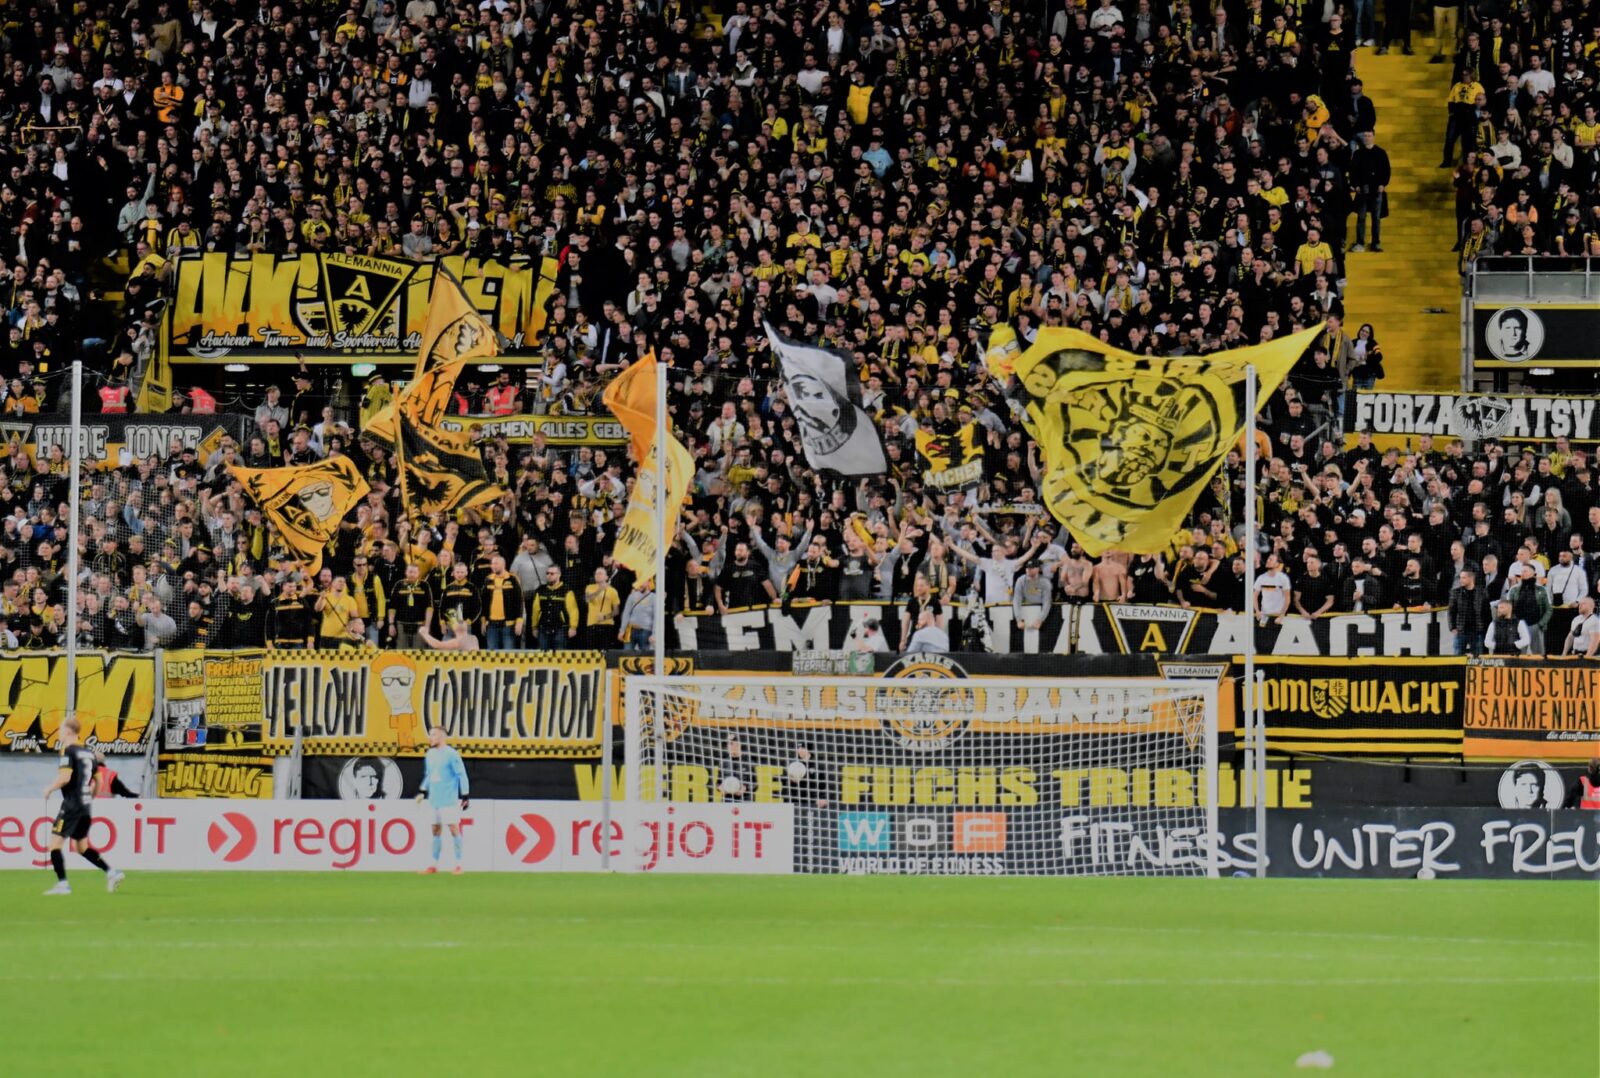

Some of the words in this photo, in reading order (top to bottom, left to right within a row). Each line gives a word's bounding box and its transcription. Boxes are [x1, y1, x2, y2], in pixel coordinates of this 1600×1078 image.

[326, 251, 403, 276] ALEMANNIA
[345, 274, 371, 301] A
[201, 331, 253, 348] Aachener
[259, 328, 300, 349] Turn-
[306, 332, 331, 348] und
[332, 331, 399, 349] Sportverein
[480, 420, 535, 438] ACHEN
[540, 421, 588, 438] ALLES
[1355, 394, 1455, 435] FORZA
[1509, 398, 1596, 438] ATSV
[1116, 607, 1189, 619] ALEMANNIA
[1140, 623, 1168, 651] A
[206, 660, 261, 676] FREIHEIT
[1166, 667, 1220, 676] ALEMANNIA
[1467, 667, 1600, 699] REUNDSCHAF
[170, 700, 202, 717] NEIN
[263, 664, 370, 740] YELLOW
[422, 665, 601, 740] CONNECTION
[697, 678, 872, 721] KARLS
[982, 680, 1154, 724] BANDE
[1350, 679, 1460, 714] WACHT
[165, 761, 261, 797] HALTUNG
[841, 766, 1039, 806] FUCHS
[1052, 762, 1312, 808] TRIBÜNE
[134, 803, 176, 854] iT
[273, 804, 416, 868] regio
[1058, 815, 1270, 869] FITNESS
[1291, 822, 1461, 872] UNTER
[839, 857, 900, 874] WORLD
[906, 857, 928, 874] OF
[932, 857, 1004, 874] FITNESS
